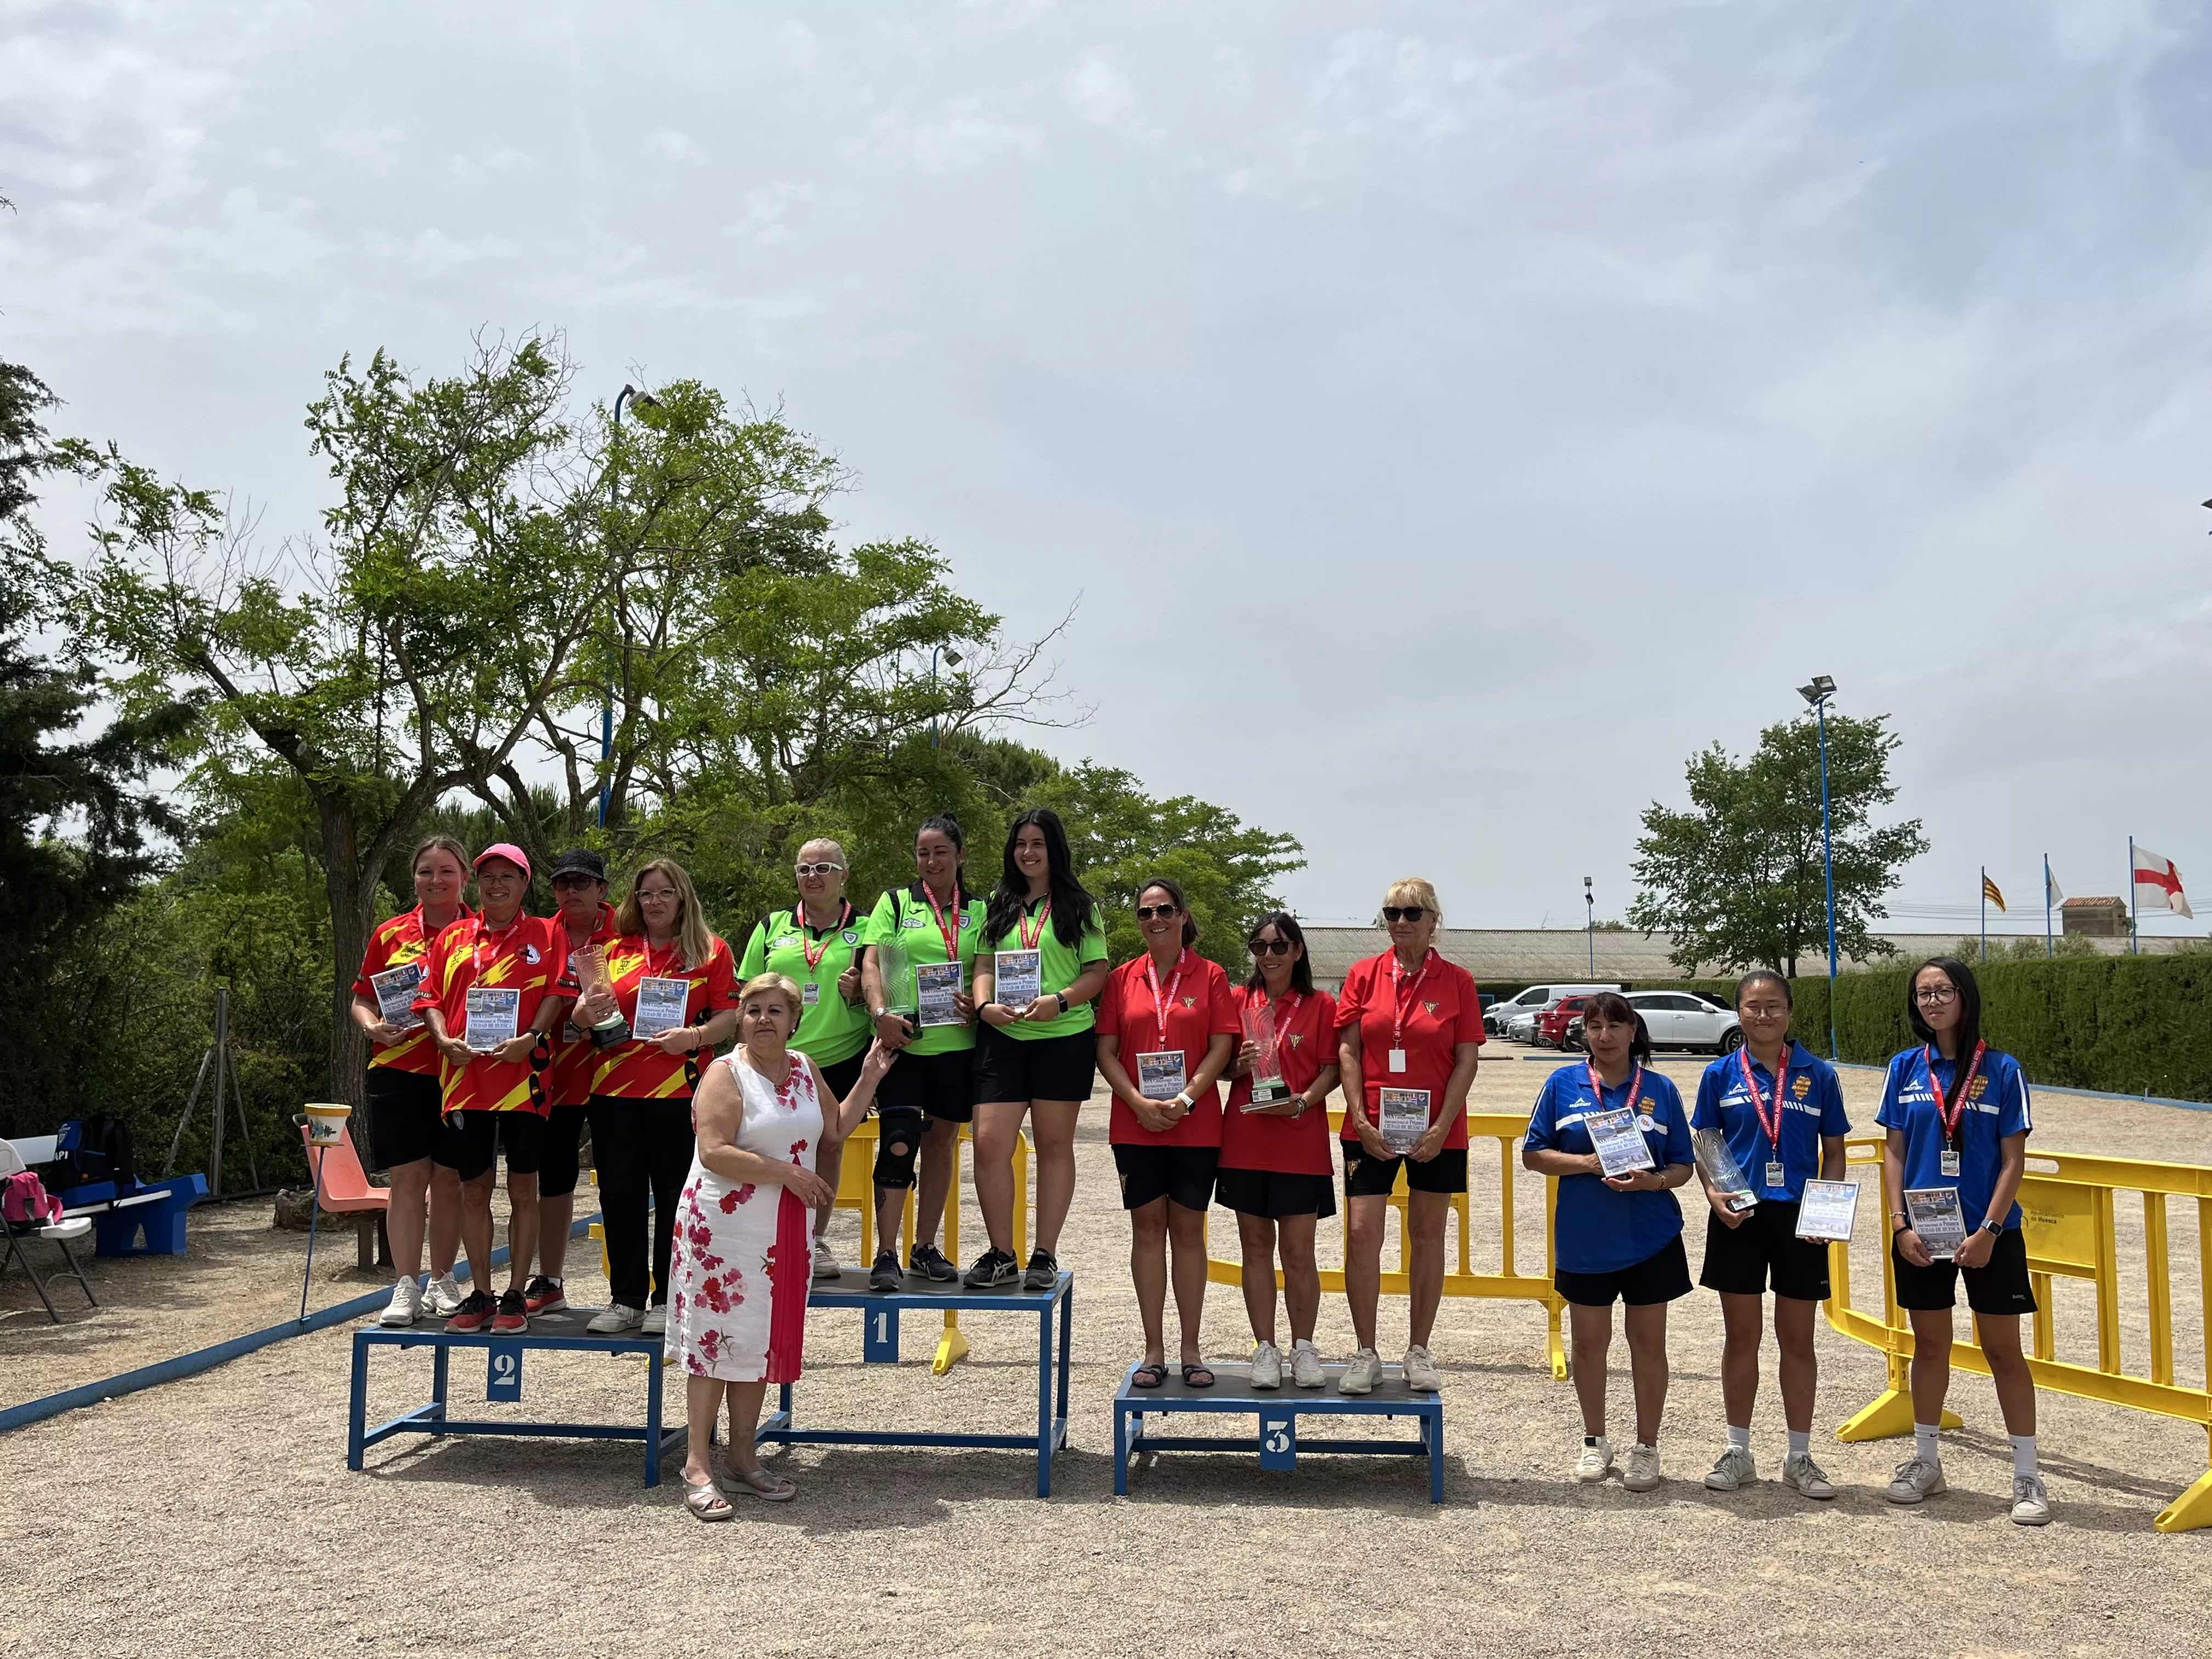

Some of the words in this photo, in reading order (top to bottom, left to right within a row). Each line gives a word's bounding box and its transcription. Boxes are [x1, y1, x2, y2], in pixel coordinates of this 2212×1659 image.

[873, 1312, 888, 1343] 1
[494, 1354, 515, 1385] 2
[1266, 1421, 1290, 1453] 3
